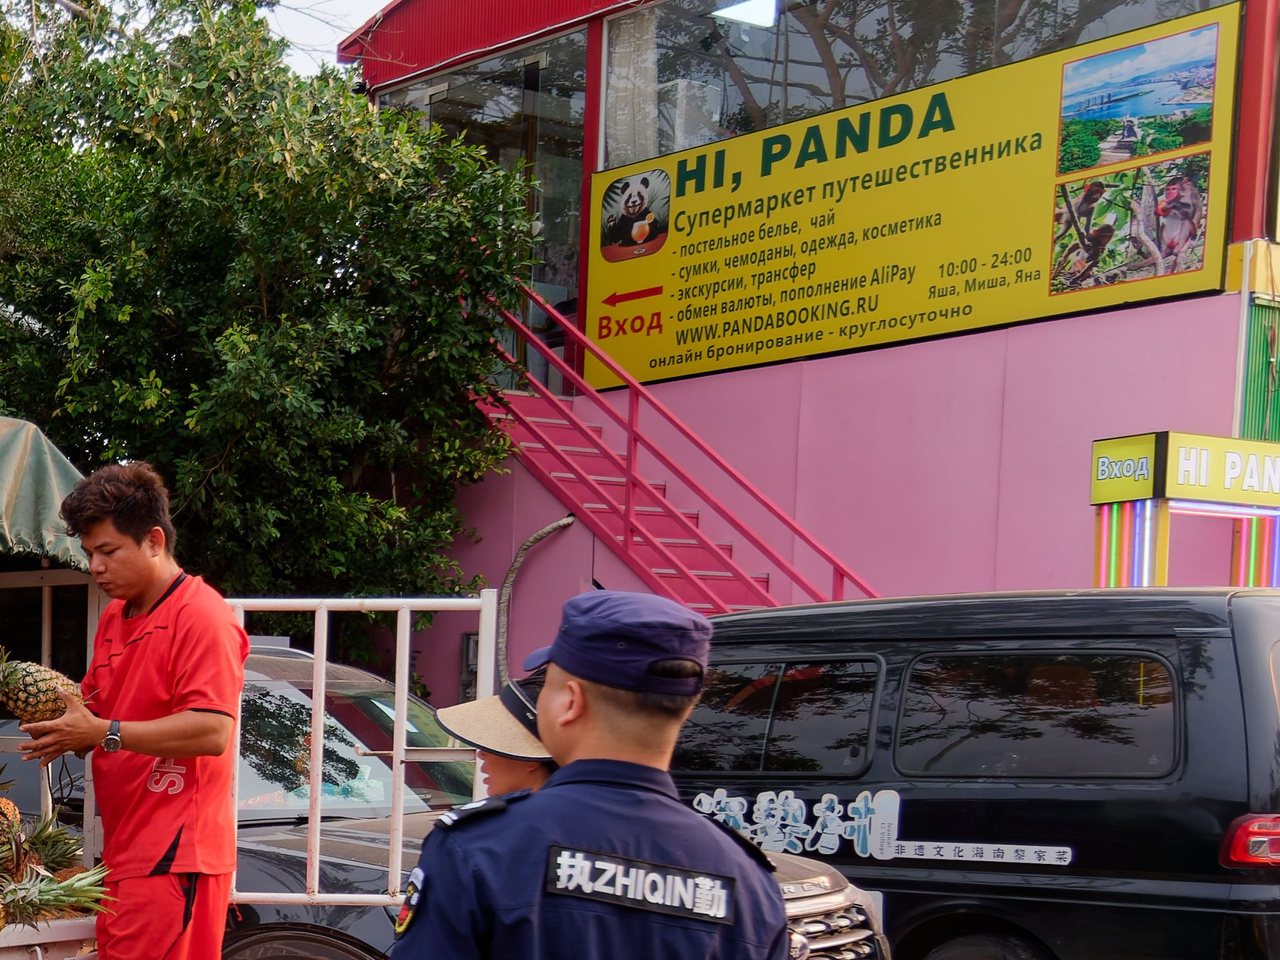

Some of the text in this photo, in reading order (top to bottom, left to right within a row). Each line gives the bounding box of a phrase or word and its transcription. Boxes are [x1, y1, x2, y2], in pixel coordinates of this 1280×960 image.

[675, 92, 956, 198] HI, PANDA
[674, 132, 1043, 237] Супермаркет путешественника
[679, 259, 720, 283] сумки,
[724, 244, 797, 270] чемоданы,
[800, 231, 858, 255] одежда,
[862, 212, 942, 242] косметика
[680, 229, 755, 258] постельное
[758, 220, 802, 243] белье,
[810, 208, 835, 229] чай
[678, 277, 747, 301] экскурсии,
[751, 261, 816, 289] трансфер
[928, 268, 1041, 299] Яша, Миша, Яна
[938, 258, 977, 278] 10:00
[991, 247, 1032, 269] 24:00
[677, 303, 717, 323] обмен
[721, 293, 776, 315] валюты,
[780, 275, 867, 303] пополнение
[870, 264, 916, 286] AliPay
[597, 312, 663, 340] Вход
[649, 348, 703, 369] онлайн
[706, 329, 824, 361] бронирование
[839, 304, 973, 339] круглосуточно
[675, 294, 880, 346] WWW.PANDABOOKING.RU
[1097, 456, 1150, 481] Вход
[1177, 446, 1280, 494] HI PAN
[894, 843, 1069, 862] 非遗文化海南黎家菜
